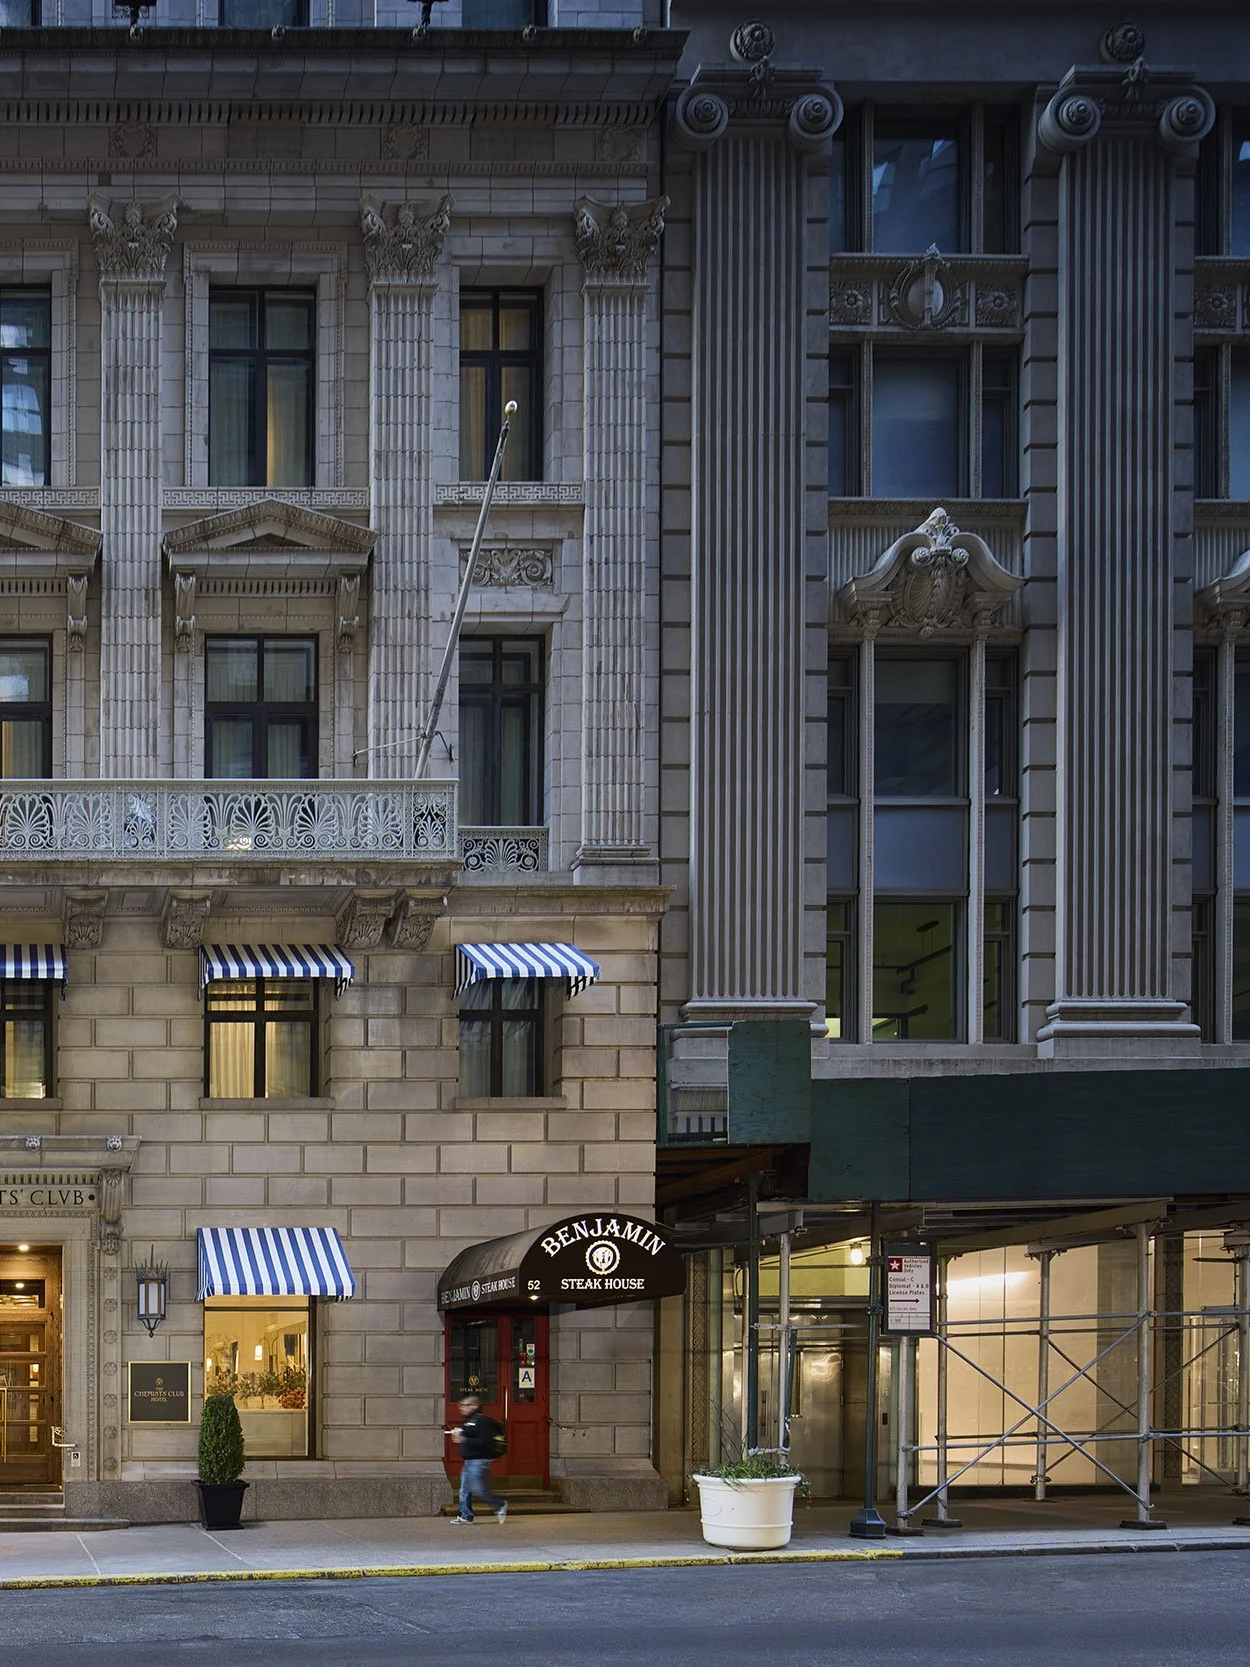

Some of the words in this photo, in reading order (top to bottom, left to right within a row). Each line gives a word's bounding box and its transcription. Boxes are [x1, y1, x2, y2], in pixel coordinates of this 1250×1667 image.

[540, 1218, 667, 1258] BENJAMIN
[441, 1286, 471, 1304] BENJAMIN
[481, 1281, 498, 1295] STEAK
[498, 1276, 516, 1290] HOUSE
[527, 1280, 541, 1290] 52
[561, 1278, 602, 1290] STEAK
[604, 1278, 645, 1290] HOUSE
[521, 1370, 532, 1383] A
